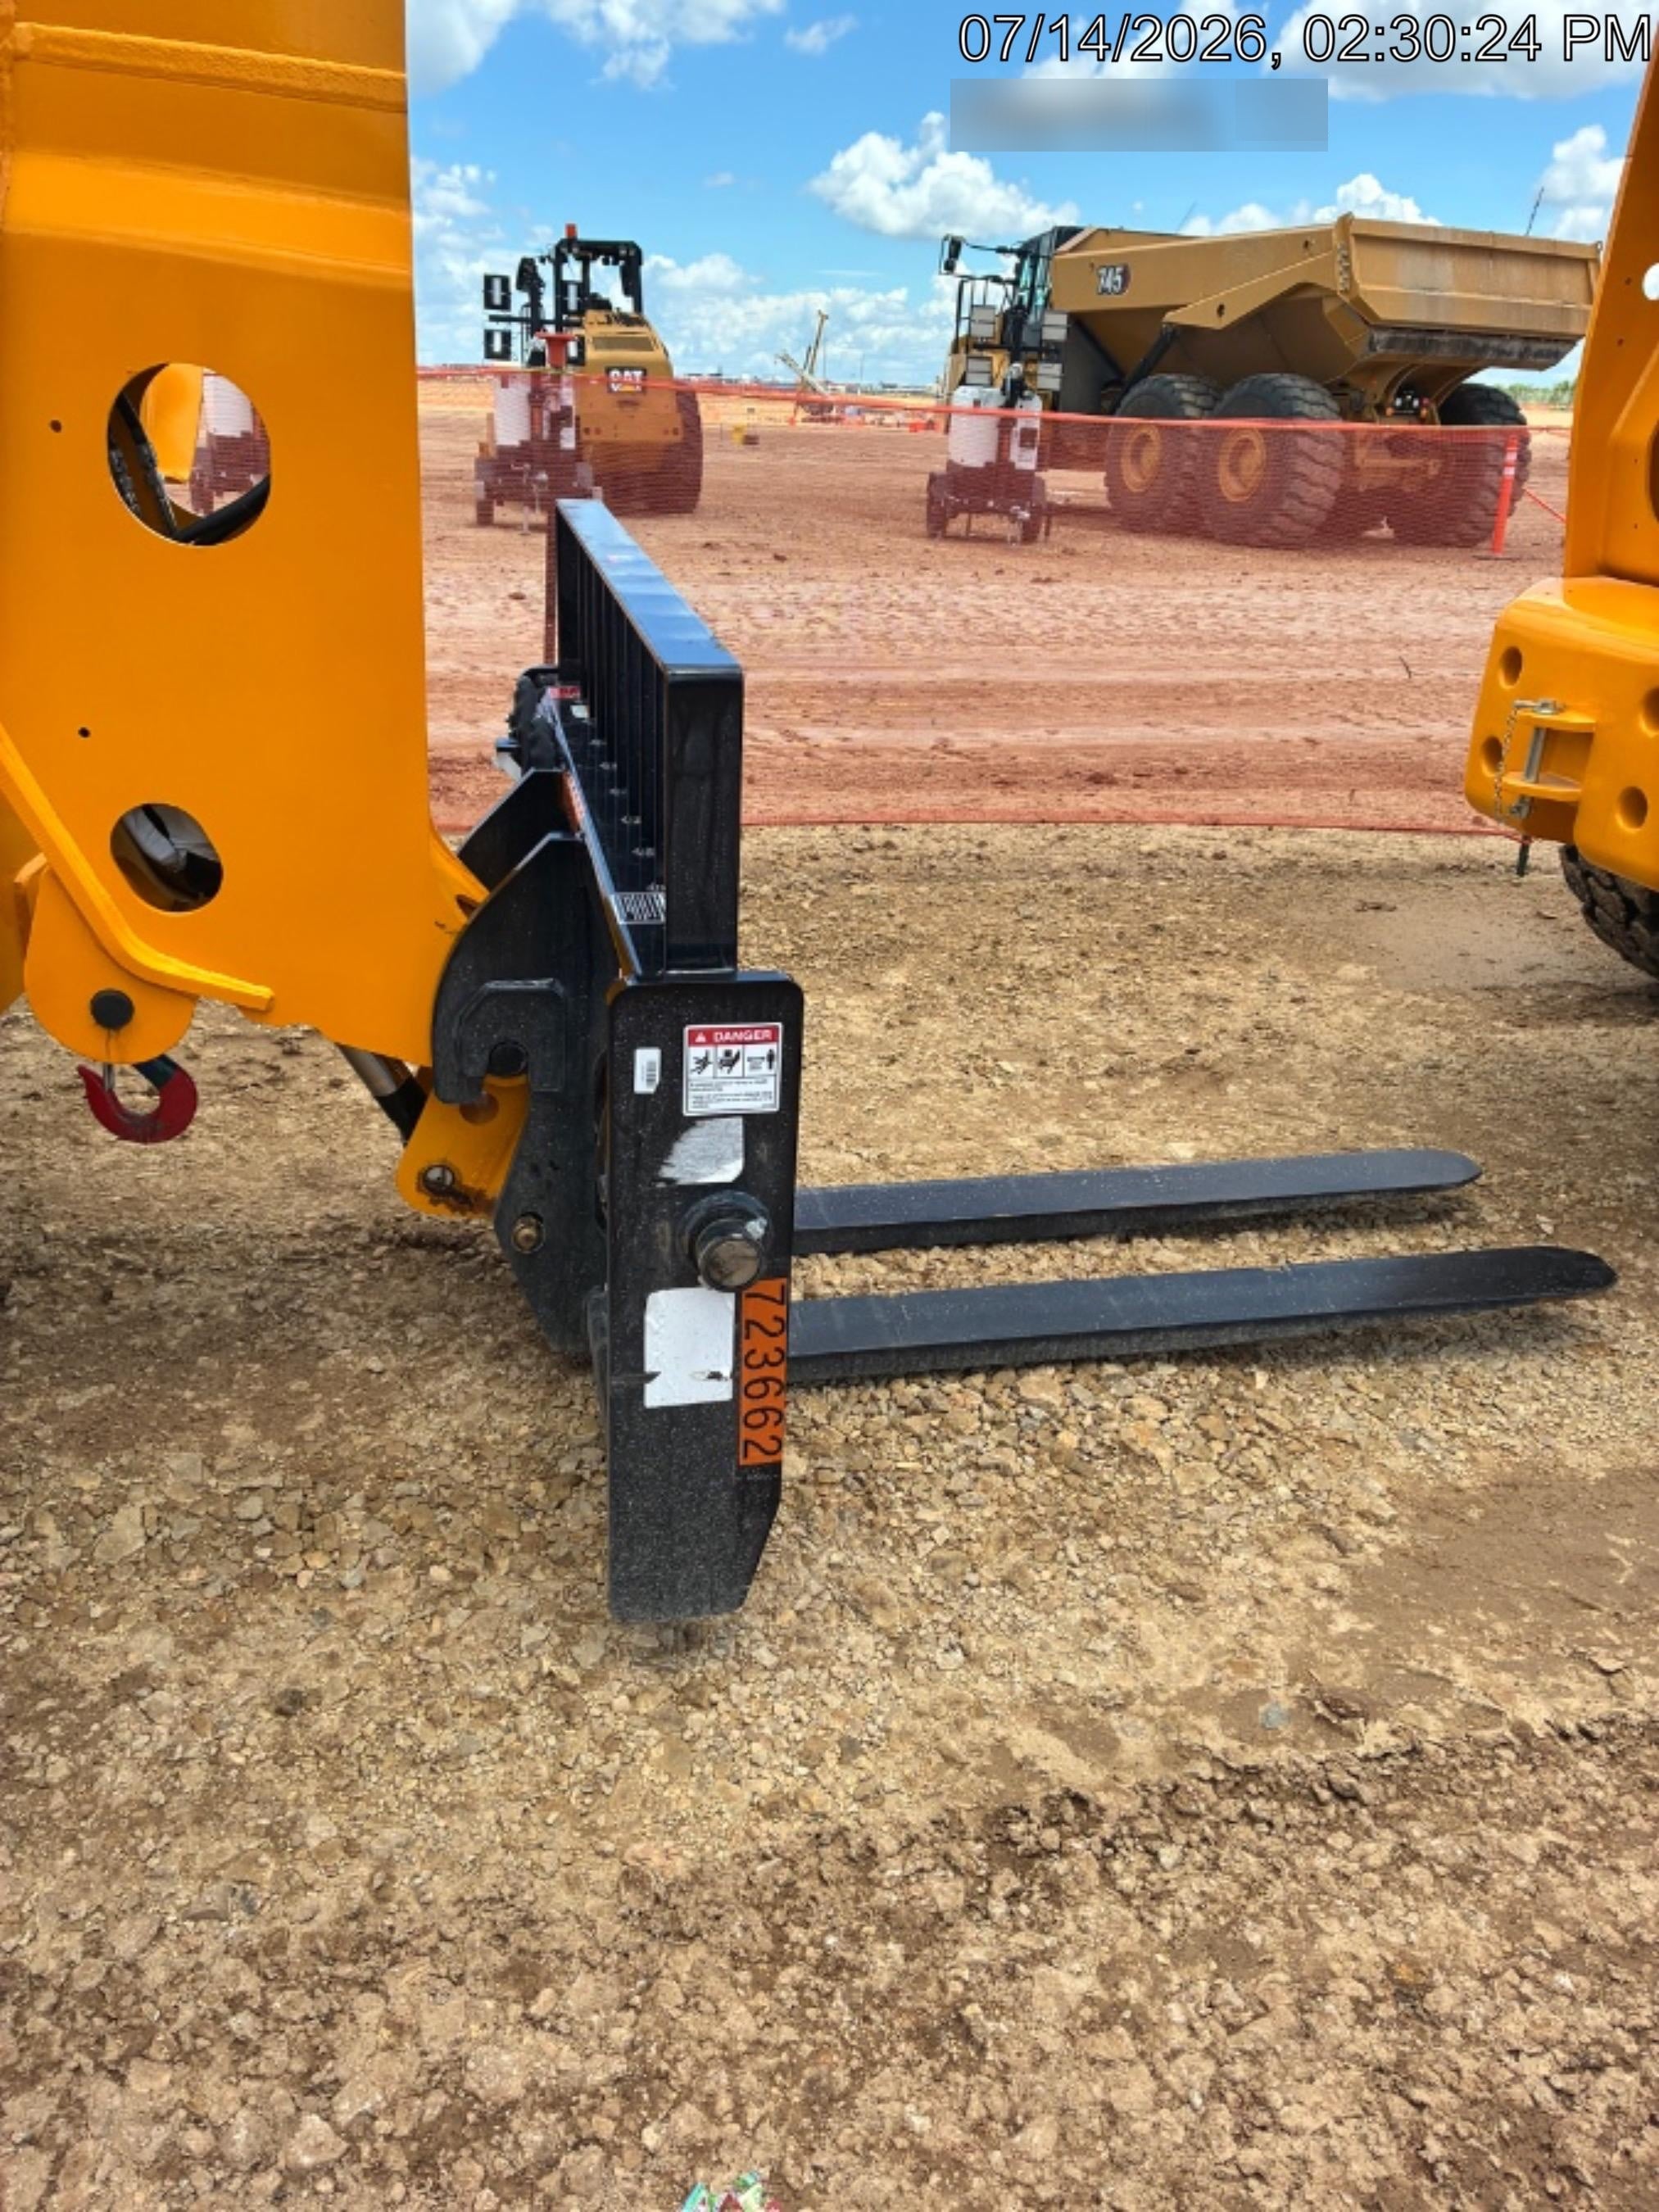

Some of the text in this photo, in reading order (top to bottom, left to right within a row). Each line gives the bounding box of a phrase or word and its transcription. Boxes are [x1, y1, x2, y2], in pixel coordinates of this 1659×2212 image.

[1098, 266, 1123, 293] 745
[609, 369, 643, 392] CAT
[713, 1029, 773, 1043] DANGER
[744, 1284, 786, 1459] 723662
